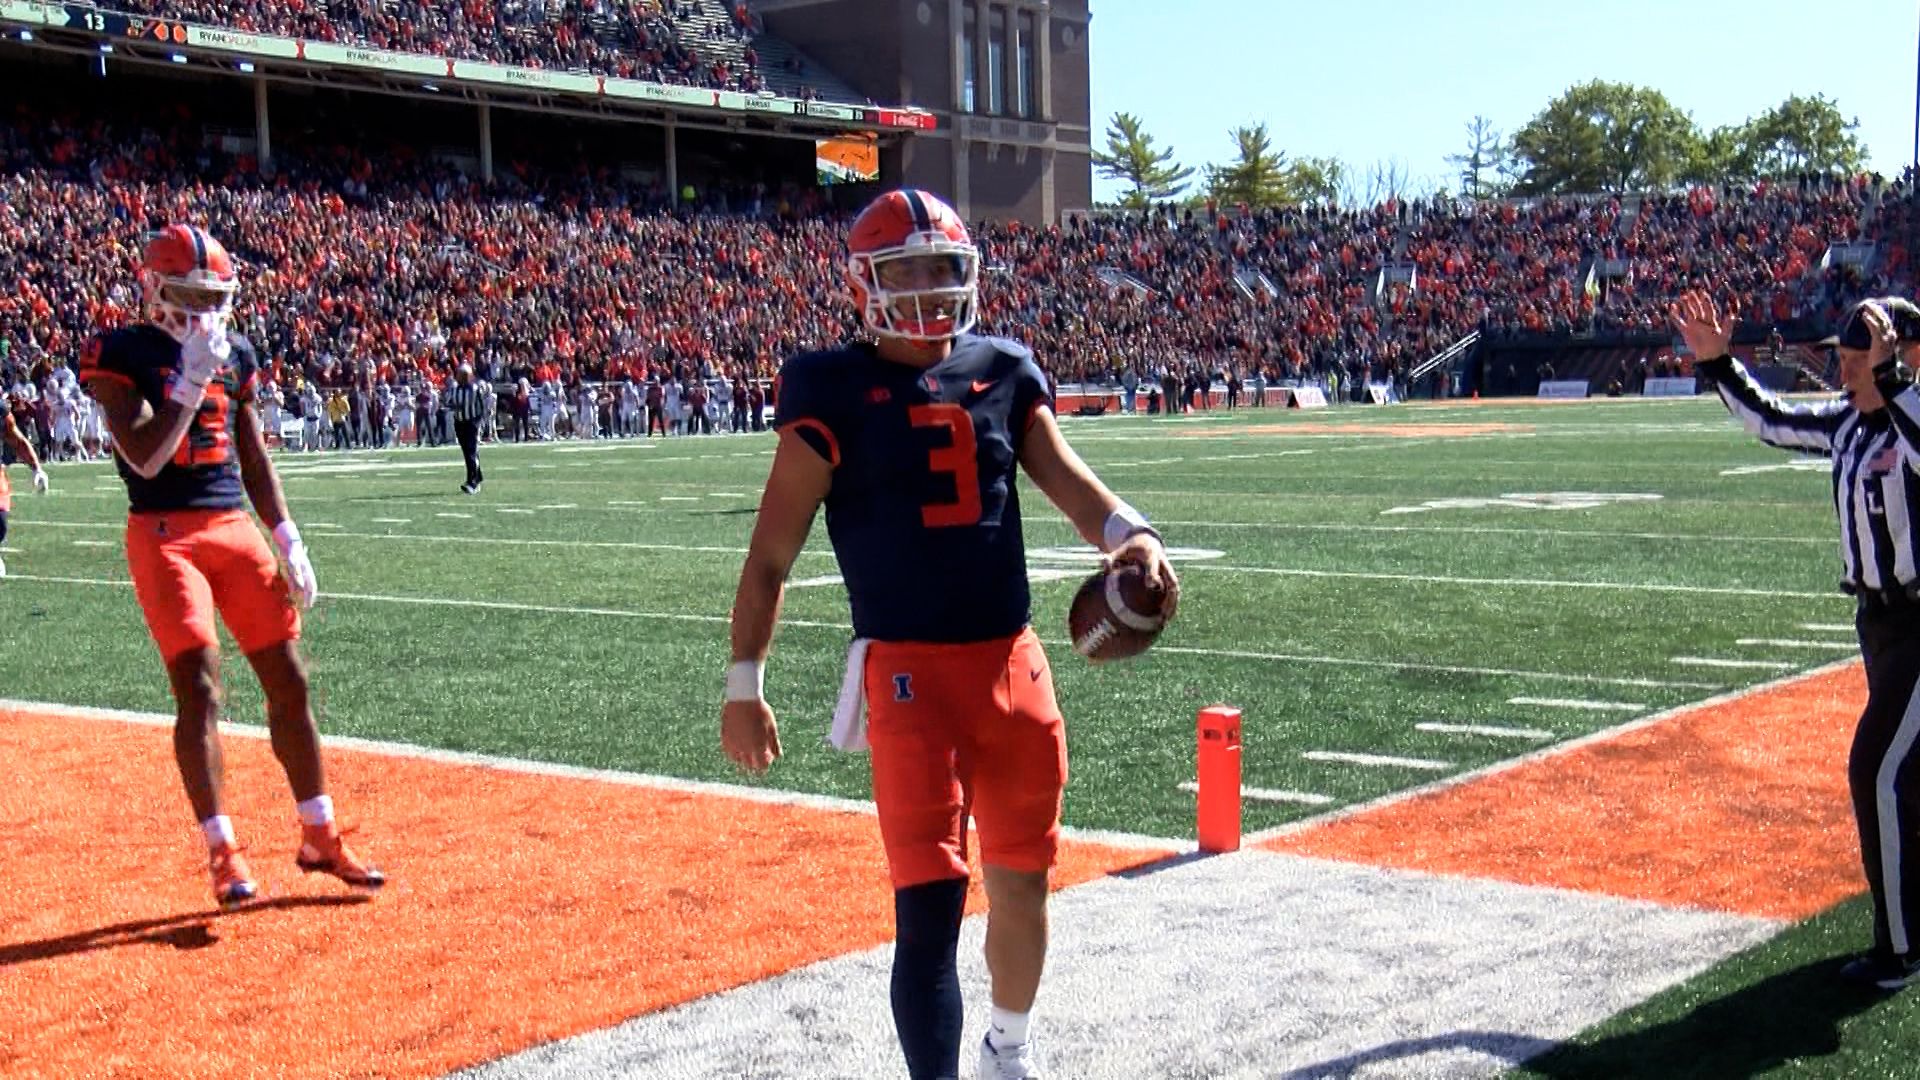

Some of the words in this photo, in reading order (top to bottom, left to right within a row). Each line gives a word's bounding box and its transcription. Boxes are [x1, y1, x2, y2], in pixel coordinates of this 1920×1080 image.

[83, 13, 105, 31] 13
[907, 402, 983, 528] 3
[1867, 492, 1885, 514] L
[892, 673, 916, 703] I
